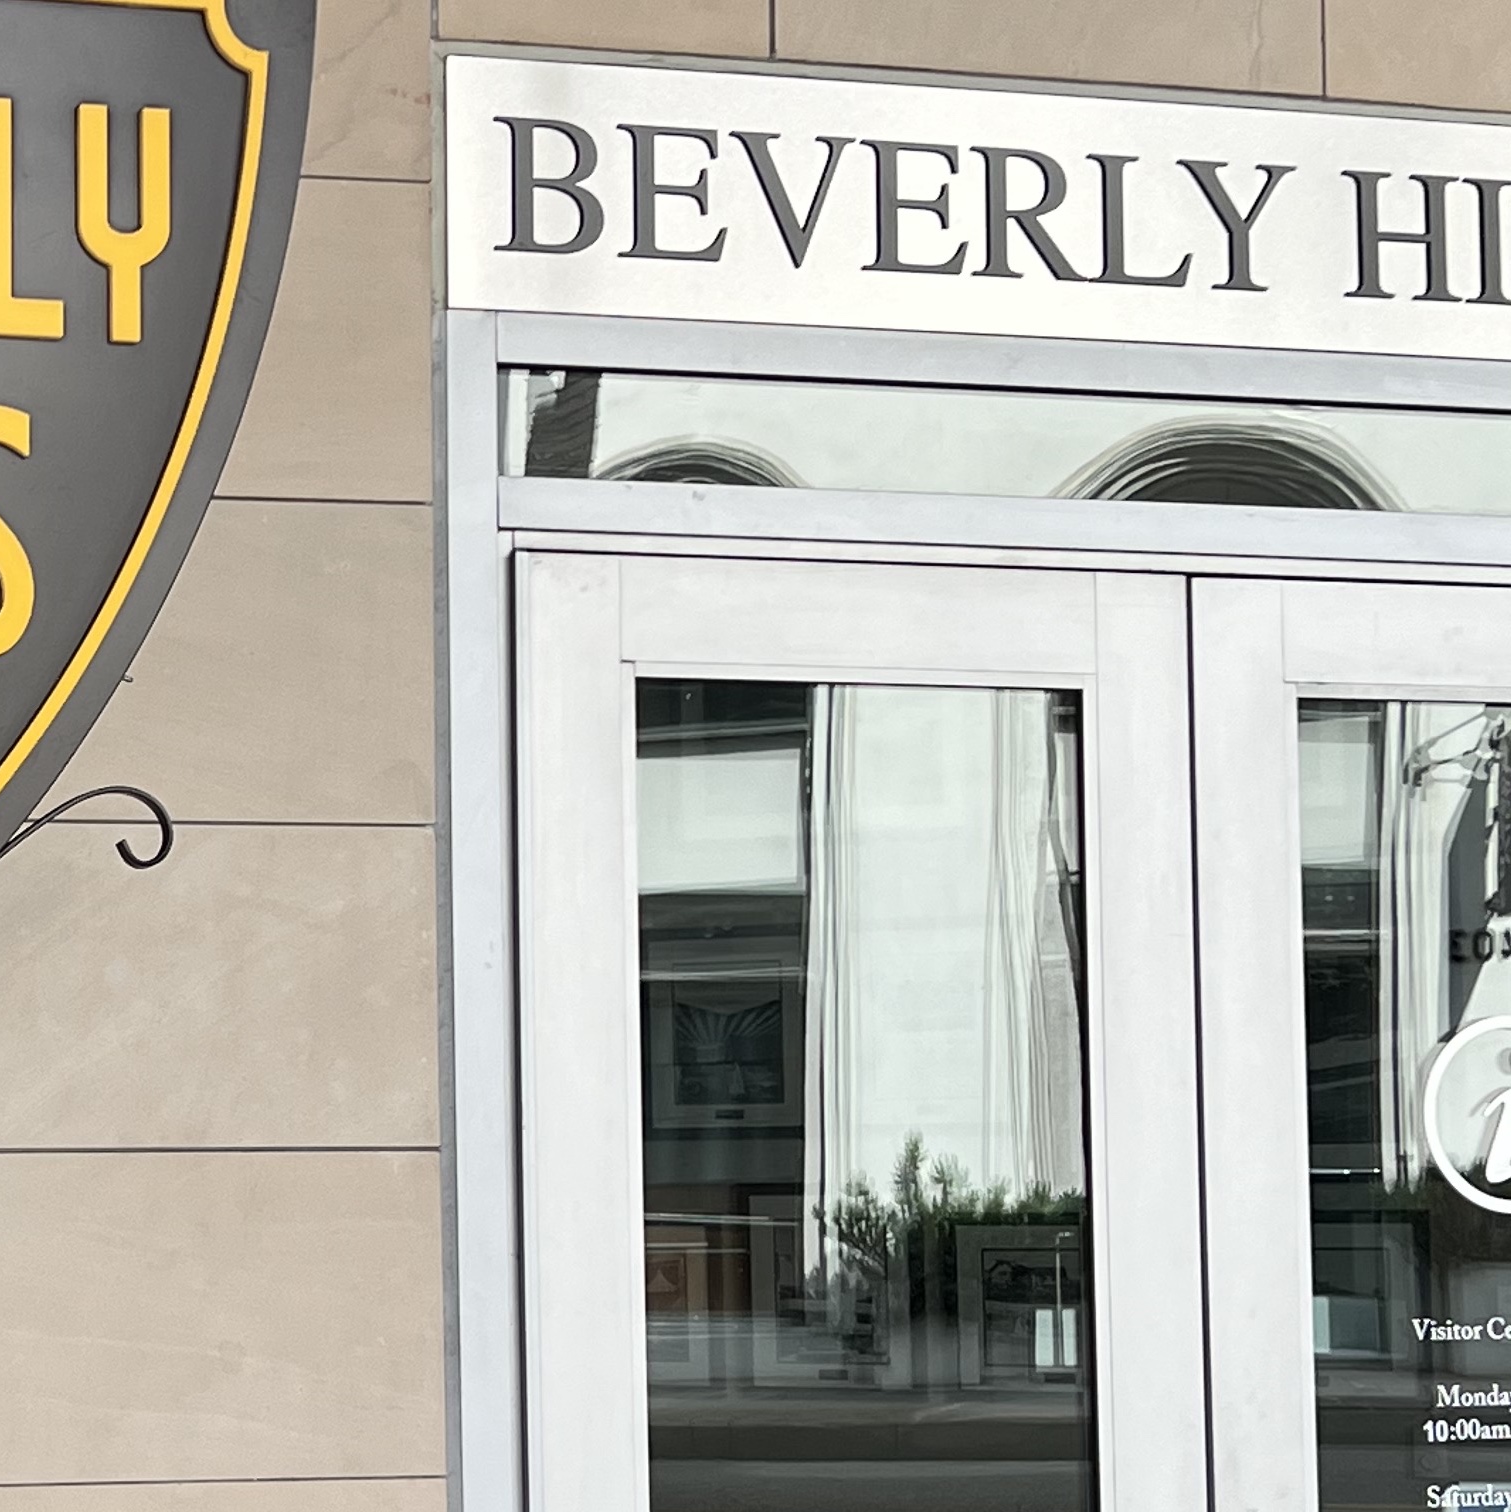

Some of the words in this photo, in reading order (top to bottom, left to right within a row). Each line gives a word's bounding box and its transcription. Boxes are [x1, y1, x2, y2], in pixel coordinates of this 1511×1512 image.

[493, 115, 1297, 292] BEVERLY
[1411, 1317, 1484, 1341] Visitor
[1436, 1383, 1511, 1414] Monda
